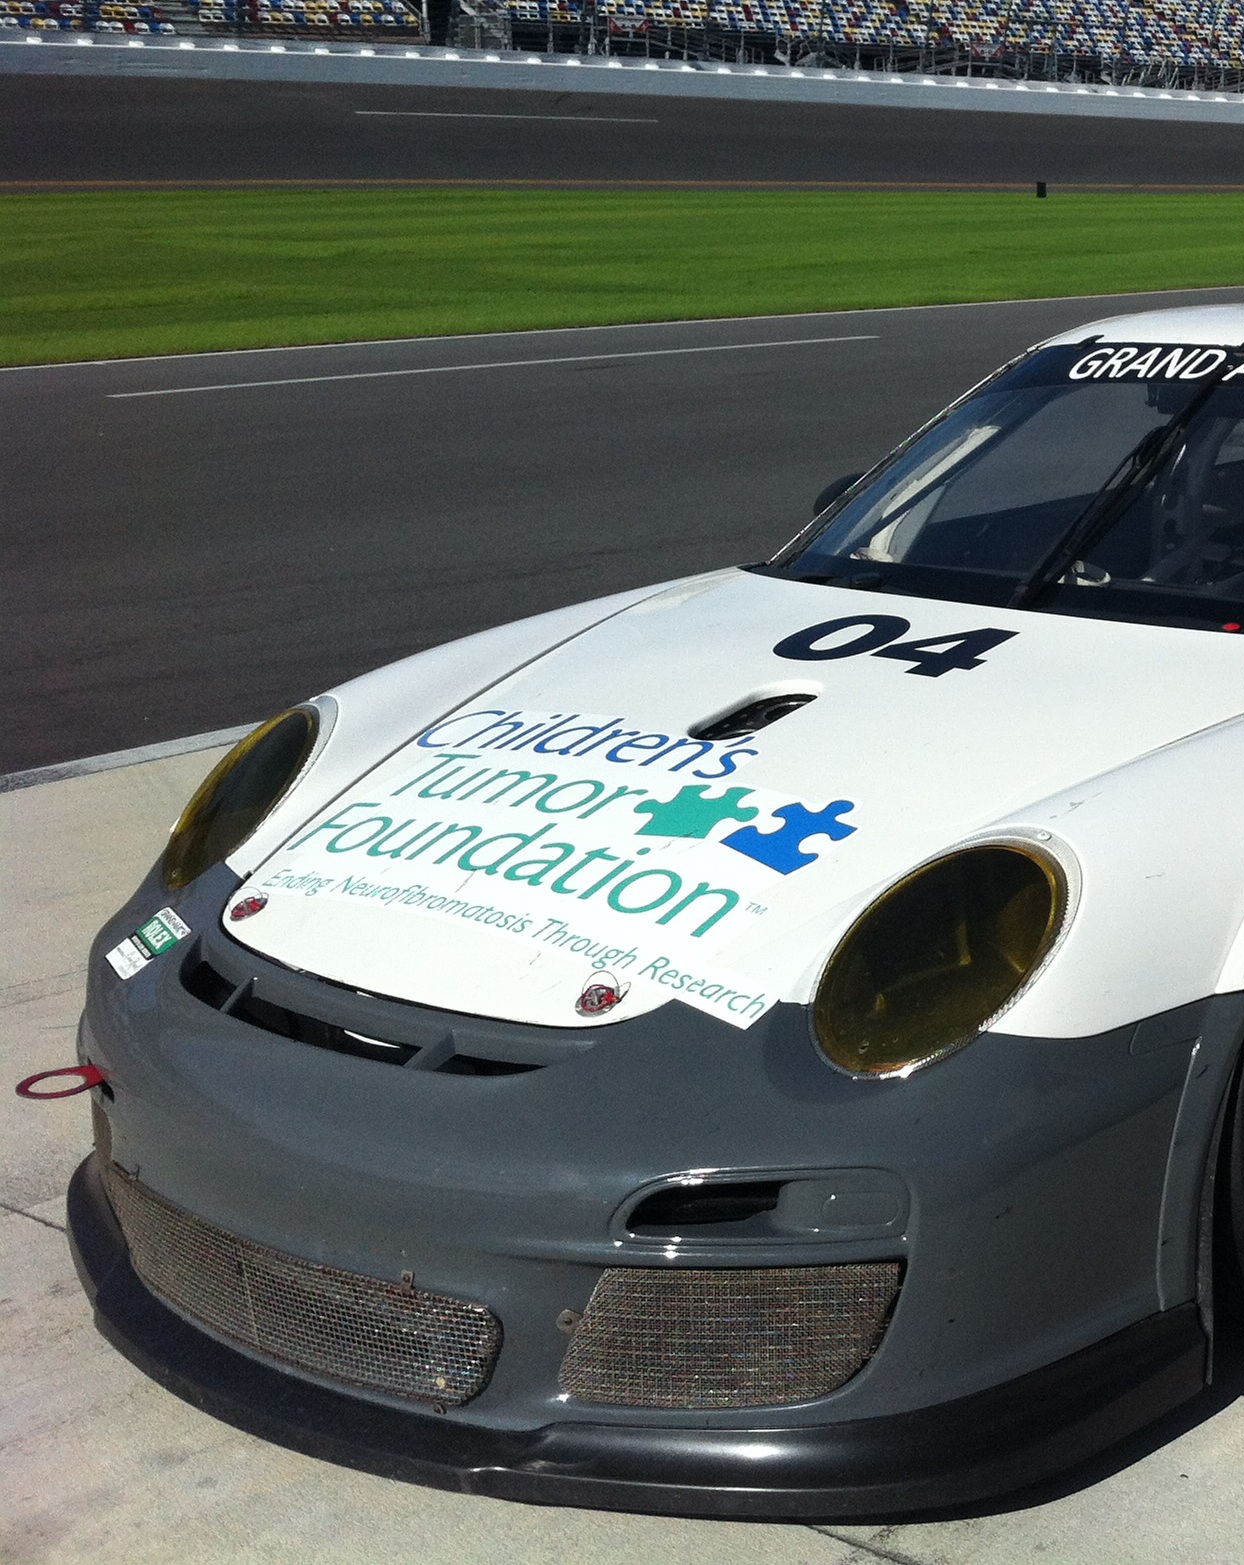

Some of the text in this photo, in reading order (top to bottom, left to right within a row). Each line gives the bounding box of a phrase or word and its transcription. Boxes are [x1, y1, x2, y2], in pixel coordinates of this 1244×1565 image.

[772, 613, 1021, 678] 04
[416, 709, 760, 779] Children's
[389, 752, 649, 820] Tumor
[286, 802, 740, 939] Foundation
[141, 919, 172, 950] ROLEX
[261, 868, 767, 1020] Ending Neurofibromatosis Through Research
